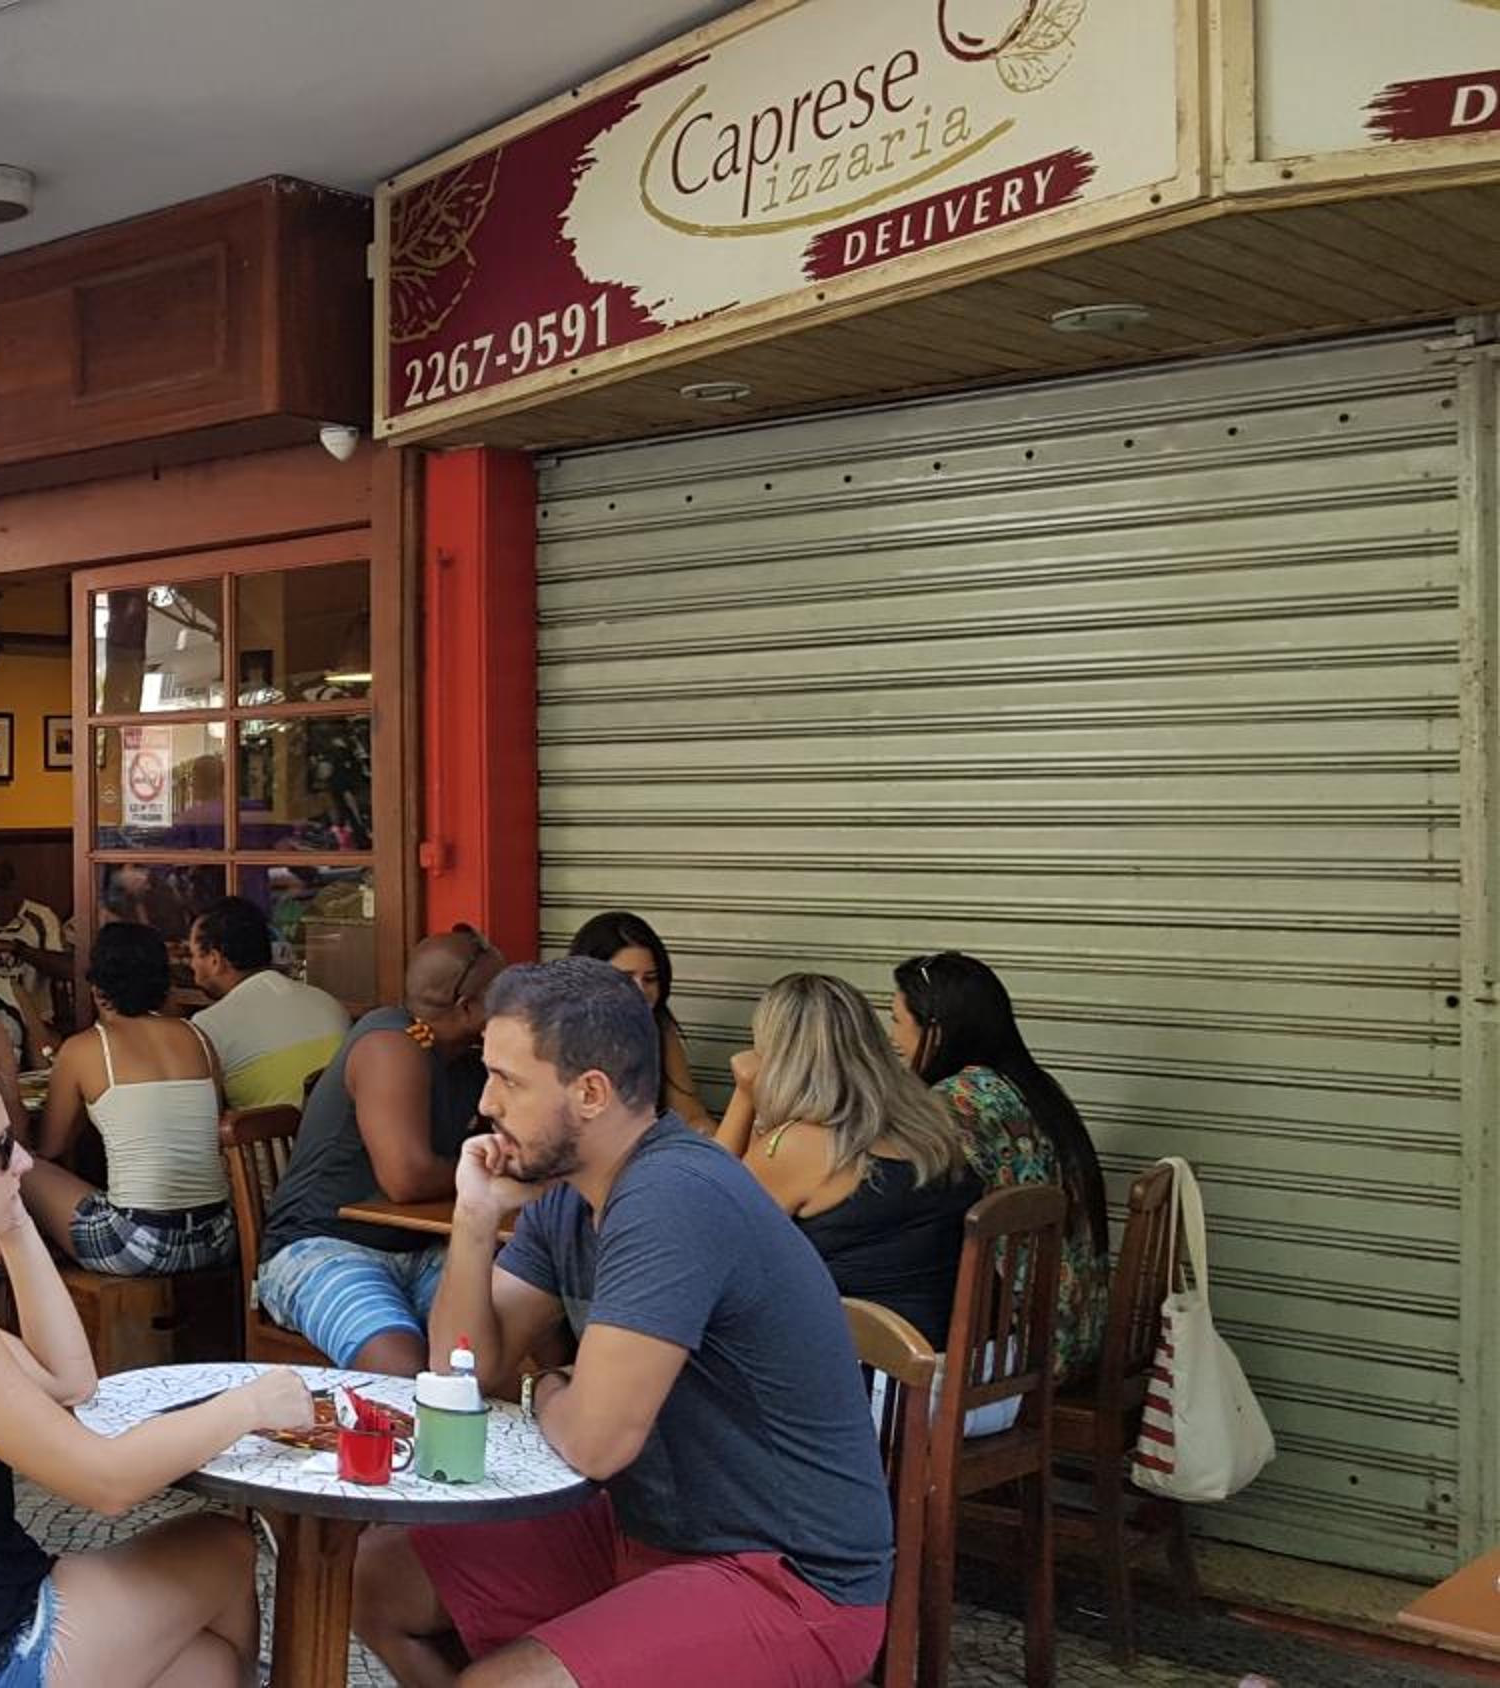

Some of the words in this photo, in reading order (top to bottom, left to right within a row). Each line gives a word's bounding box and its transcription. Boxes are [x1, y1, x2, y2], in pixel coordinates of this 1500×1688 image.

[670, 49, 919, 218] Caprese
[843, 166, 1055, 266] DELIVERY
[404, 292, 608, 407] 2267-9591
